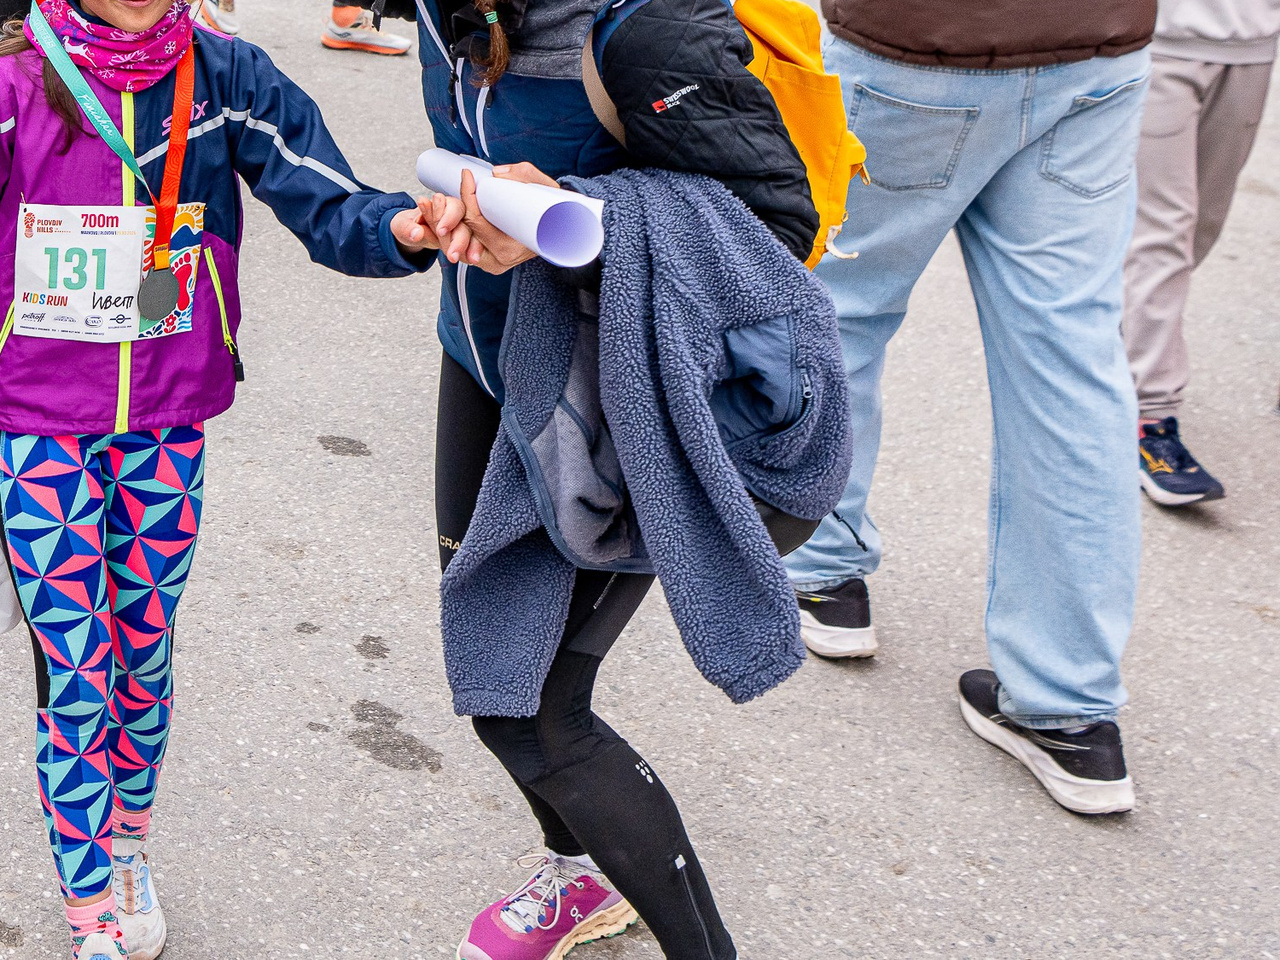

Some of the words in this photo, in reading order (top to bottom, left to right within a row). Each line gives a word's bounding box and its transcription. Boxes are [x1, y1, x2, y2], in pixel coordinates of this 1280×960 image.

[663, 84, 700, 104] SWISSWOOL
[37, 219, 63, 227] PLOVDIV
[81, 214, 119, 228] 700m
[37, 226, 54, 234] HILLS
[44, 247, 107, 290] 131
[22, 291, 46, 305] KIDS
[46, 295, 69, 307] RUN
